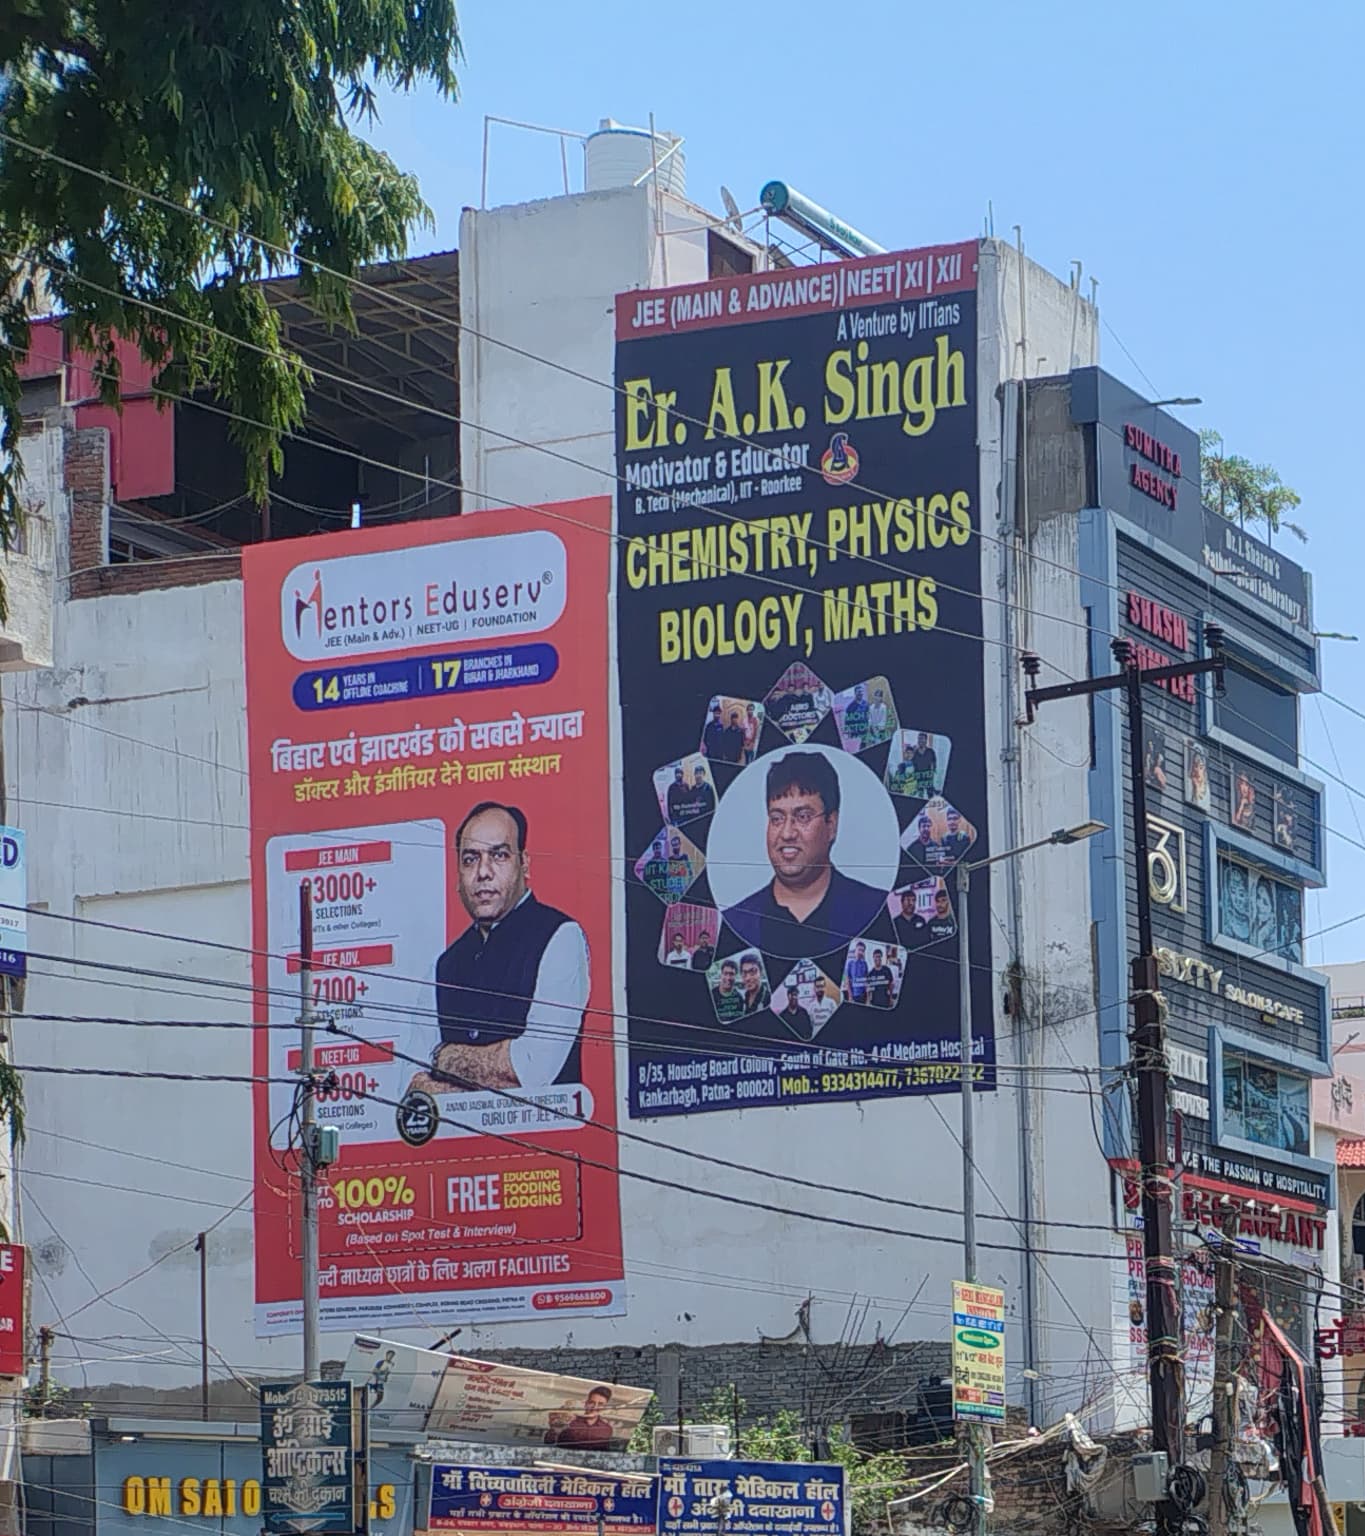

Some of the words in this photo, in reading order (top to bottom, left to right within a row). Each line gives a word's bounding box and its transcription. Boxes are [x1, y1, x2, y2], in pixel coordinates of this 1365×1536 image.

[632, 298, 667, 328] JEE
[671, 287, 723, 329] (MAIN
[849, 310, 897, 339] Venture
[900, 306, 916, 338] by
[919, 302, 961, 330] IITians
[623, 377, 688, 452] Er.
[704, 359, 806, 442] A.K.
[824, 334, 967, 437] Singh
[1124, 422, 1183, 479] SUMITRA
[625, 454, 712, 493] Motivator
[715, 450, 728, 479] &
[730, 442, 810, 477] Educator
[634, 496, 646, 515] B.
[647, 495, 670, 513] Tech
[760, 474, 802, 497] Roorkee
[1131, 463, 1179, 511] AGENCY
[626, 512, 819, 590] CHEMISTRY,
[827, 490, 972, 562] PHYSICS
[324, 634, 342, 649] JEE
[344, 630, 371, 647] (Main
[416, 620, 460, 636] NEET-UG
[471, 611, 538, 629] FOUNDATION
[659, 592, 814, 664] BIOLOGY,
[823, 576, 939, 642] MATHS
[1127, 590, 1190, 653] SHASHI
[313, 675, 341, 704] 14
[431, 659, 462, 689] 17
[271, 738, 325, 773] बिहार
[328, 731, 356, 767] एवं
[361, 723, 435, 765] झारखंड
[439, 717, 466, 753] को
[470, 711, 524, 750] सबसे
[528, 709, 585, 744] ज्यादा
[294, 776, 340, 803] डॉक्टर
[343, 769, 371, 798] और
[374, 768, 437, 797] इंजीनियर
[439, 759, 462, 787] देने
[467, 758, 505, 783] वाला
[508, 752, 562, 779] संस्थान
[318, 851, 334, 866] JEE
[334, 848, 360, 864] MAIN
[315, 904, 364, 920] SELECTIONS
[312, 975, 369, 1007] 7100+
[320, 1048, 360, 1065] NEET-UG
[667, 1059, 708, 1082] Housing
[709, 1057, 739, 1077] Board
[893, 1040, 938, 1061] Medanta
[736, 1078, 774, 1099] 800020
[317, 1104, 366, 1120] SELECTIONS
[406, 1104, 429, 1127] 25
[481, 1111, 506, 1127] GURU
[507, 1110, 519, 1125] OF
[333, 1174, 416, 1209] 100%
[502, 1169, 560, 1183] EDUCATION
[502, 1180, 562, 1197] FOODING
[1202, 1155, 1221, 1174] THE
[1223, 1160, 1261, 1186] PASSION
[1262, 1170, 1275, 1188] OF
[1276, 1174, 1328, 1201] HOSPITALITY
[447, 1173, 501, 1215] FREE
[502, 1193, 563, 1211] LODGING
[337, 1208, 415, 1227] SCHOLARSHIP
[345, 1231, 383, 1248] (Based
[401, 1228, 426, 1244] Spot
[427, 1227, 452, 1241] Test
[463, 1222, 517, 1239] Interview)
[340, 1266, 384, 1286] माध्यम
[386, 1258, 416, 1285] छात्रों
[417, 1259, 431, 1282] के
[432, 1257, 460, 1281] लिए
[461, 1261, 497, 1279] अलग
[499, 1254, 571, 1277] FACILITIES
[123, 1475, 172, 1518] OM
[181, 1478, 237, 1518] SAI
[312, 1486, 347, 1512] दुकान
[559, 1476, 617, 1498] मेडिकल
[734, 1474, 800, 1501] मेडिकल
[804, 1477, 841, 1501] हॉल
[748, 1503, 816, 1520] दवाखाना
